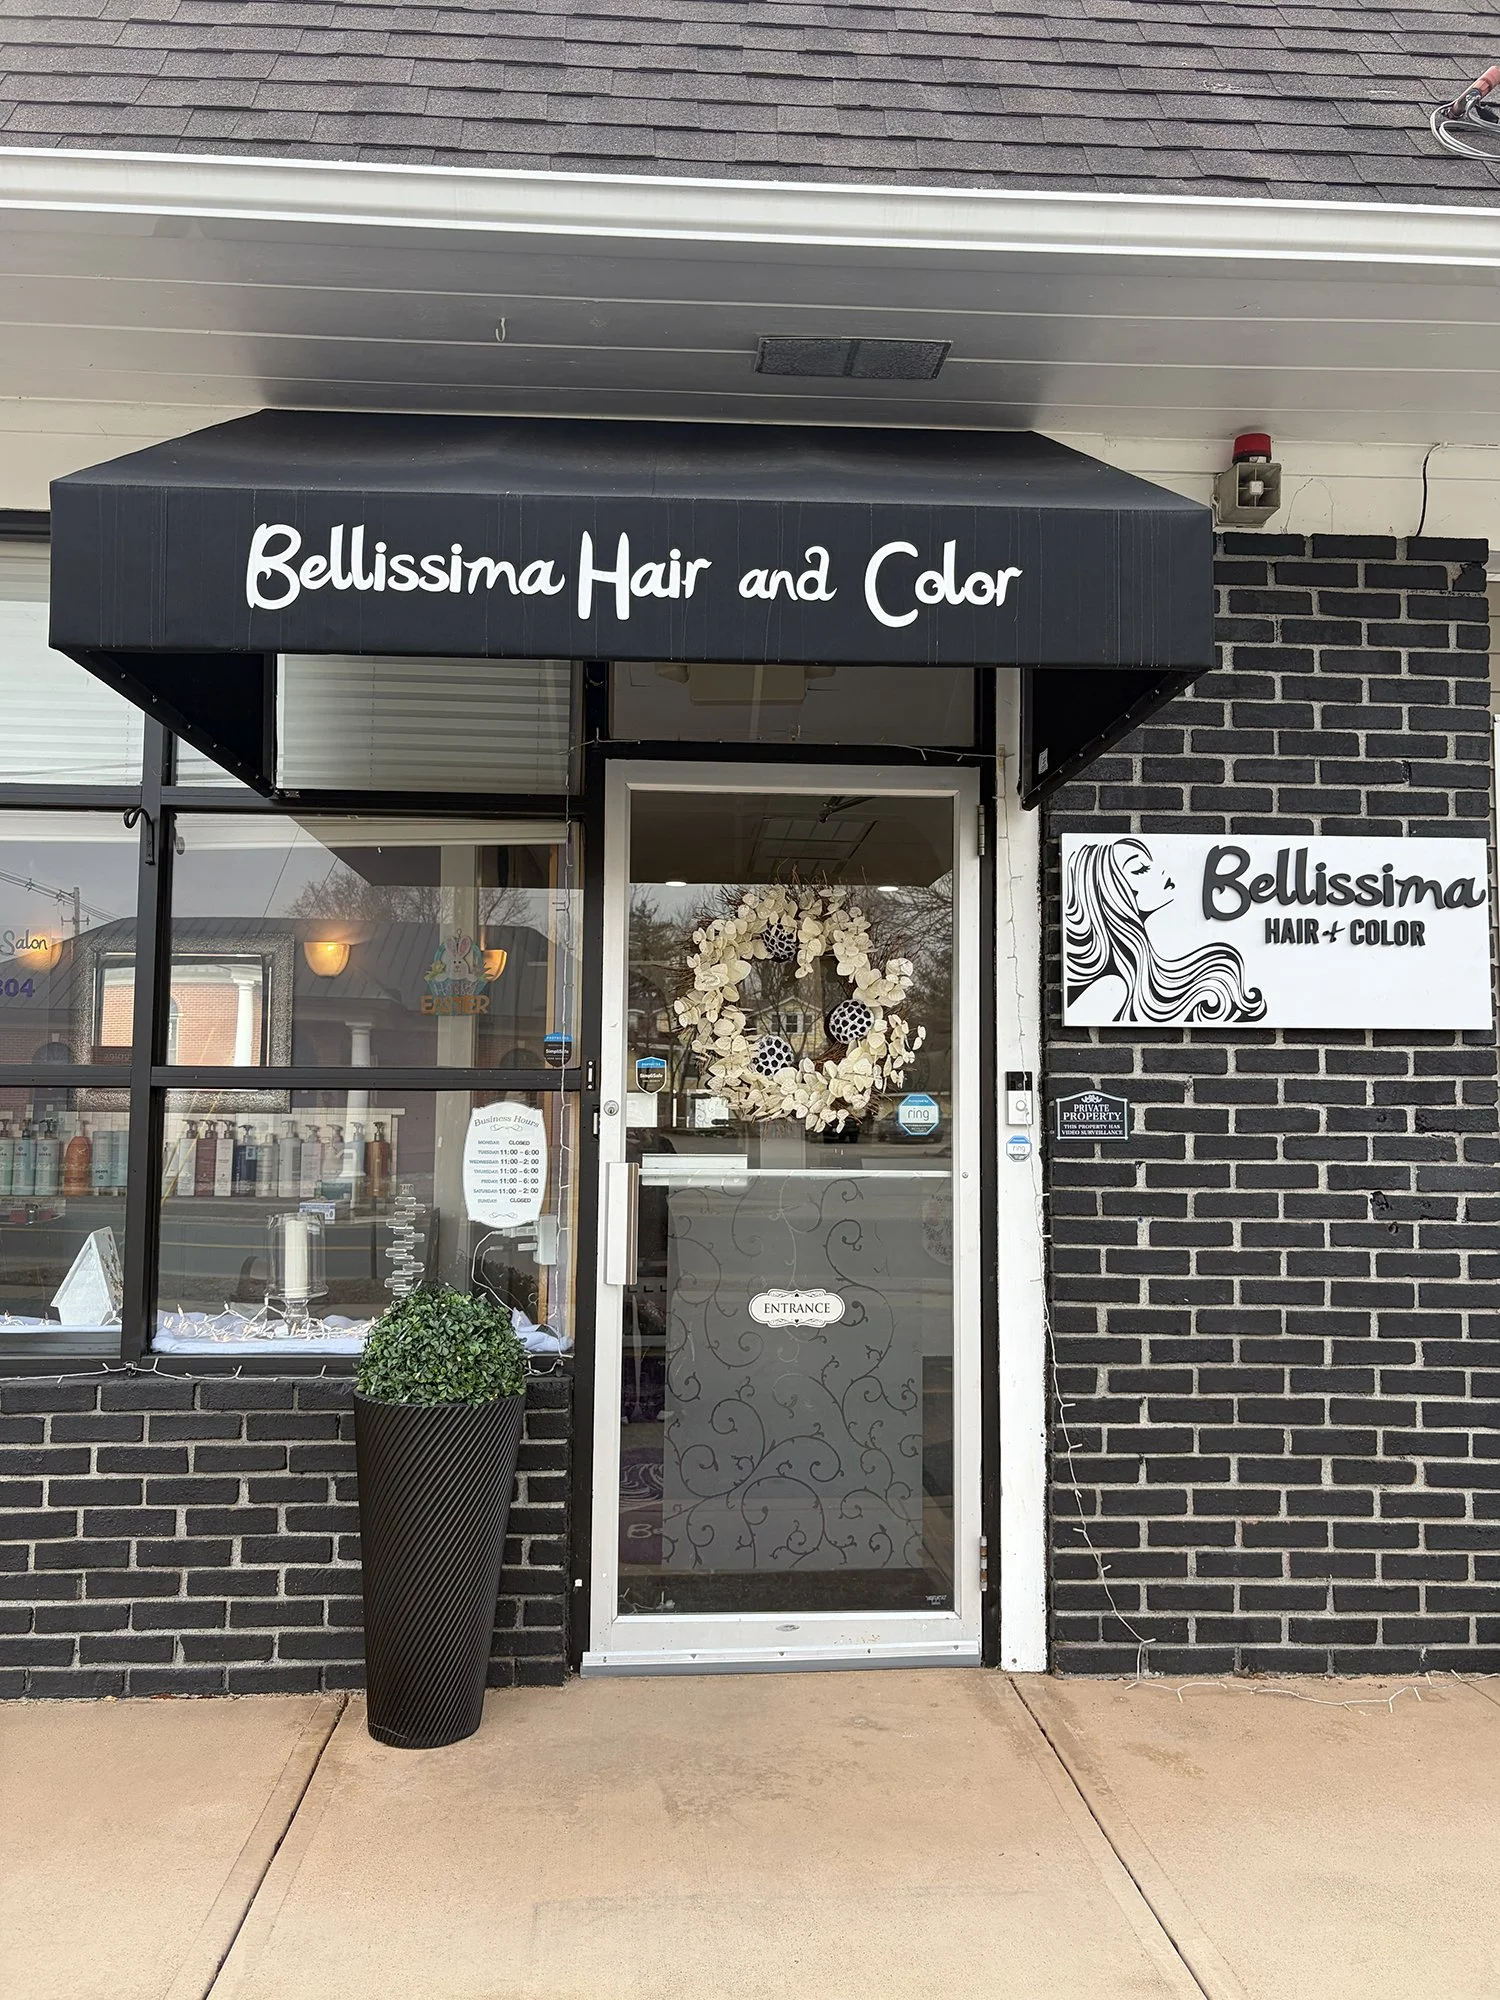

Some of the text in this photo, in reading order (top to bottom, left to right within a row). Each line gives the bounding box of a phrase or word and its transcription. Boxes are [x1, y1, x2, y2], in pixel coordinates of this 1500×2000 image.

[245, 523, 1023, 628] Bellissima Hair and Color
[1202, 845, 1486, 921] Bellissima
[1265, 918, 1426, 946] HAIR COLOR
[0, 929, 48, 956] Salon
[907, 1108, 930, 1121] ring
[1073, 1104, 1110, 1112] PRIVATE
[474, 1115, 540, 1129] Business Hours
[1063, 1112, 1122, 1121] PROPERTY
[764, 1303, 831, 1314] ENTRANCE
